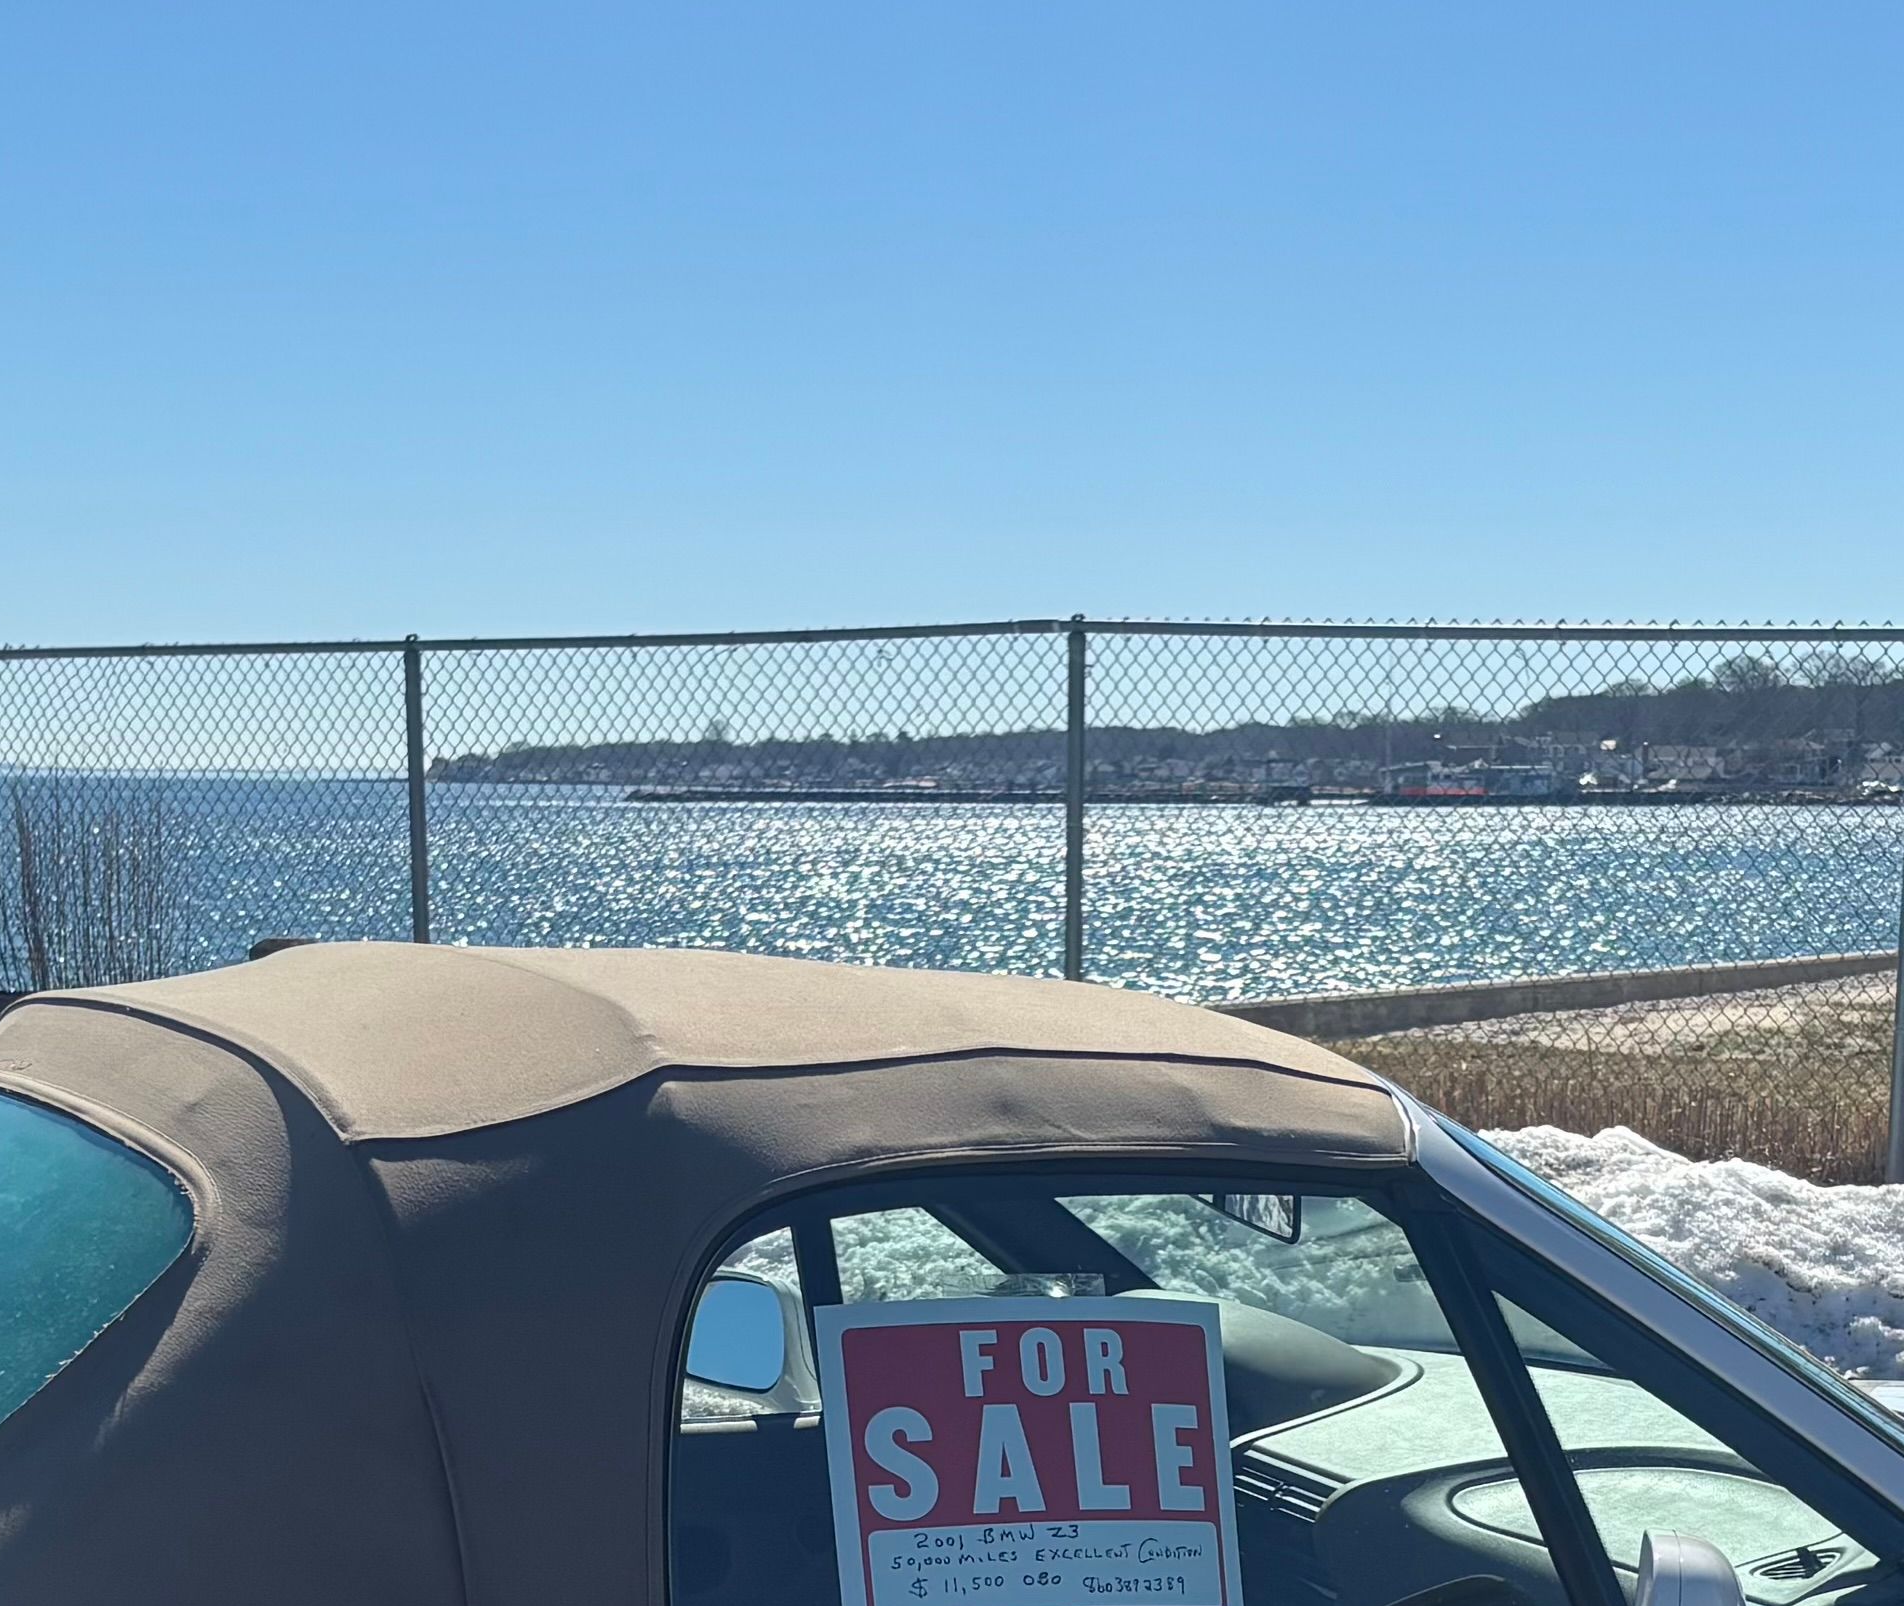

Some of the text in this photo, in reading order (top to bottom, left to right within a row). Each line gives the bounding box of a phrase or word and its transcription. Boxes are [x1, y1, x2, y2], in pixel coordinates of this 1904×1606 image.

[959, 1327, 1129, 1397] FOR
[863, 1402, 1206, 1522] SALE
[914, 1523, 1080, 1551] 2001 BMW Z3
[890, 1555, 951, 1572] 50,000
[1035, 1543, 1133, 1562] EXCELLENT
[908, 1577, 929, 1599] $
[944, 1575, 1005, 1596] 11,500
